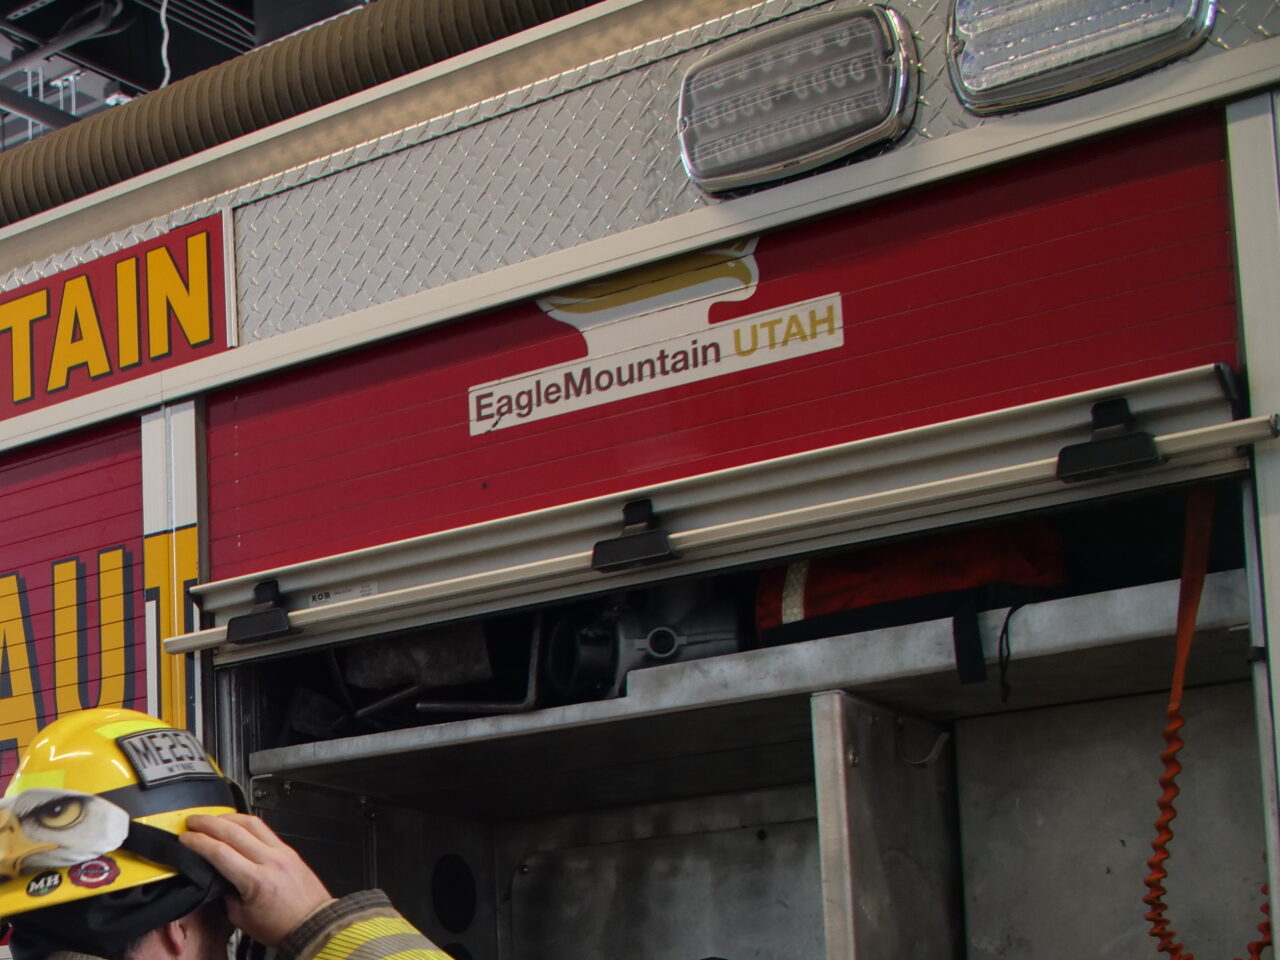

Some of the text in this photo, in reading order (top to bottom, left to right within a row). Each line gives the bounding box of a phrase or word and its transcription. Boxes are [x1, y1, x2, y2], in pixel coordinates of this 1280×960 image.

[475, 304, 836, 422] EagleMountain UTAH
[28, 873, 61, 893] MH
